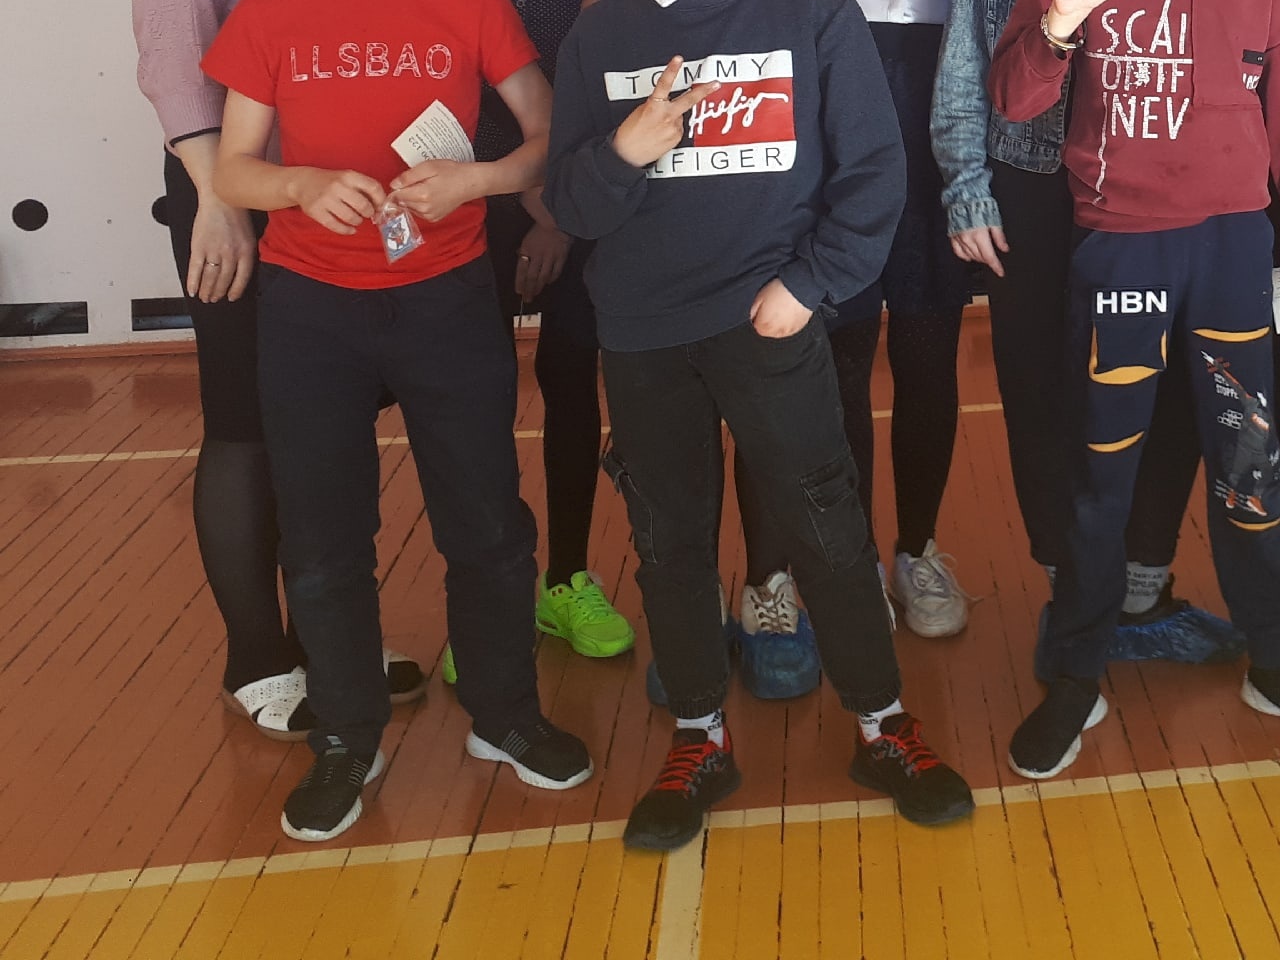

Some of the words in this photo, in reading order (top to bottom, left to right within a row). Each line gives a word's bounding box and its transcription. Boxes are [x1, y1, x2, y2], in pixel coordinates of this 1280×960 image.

[290, 42, 452, 81] LLSBAO
[654, 147, 782, 173] LFIGER
[1096, 290, 1167, 314] HBN
